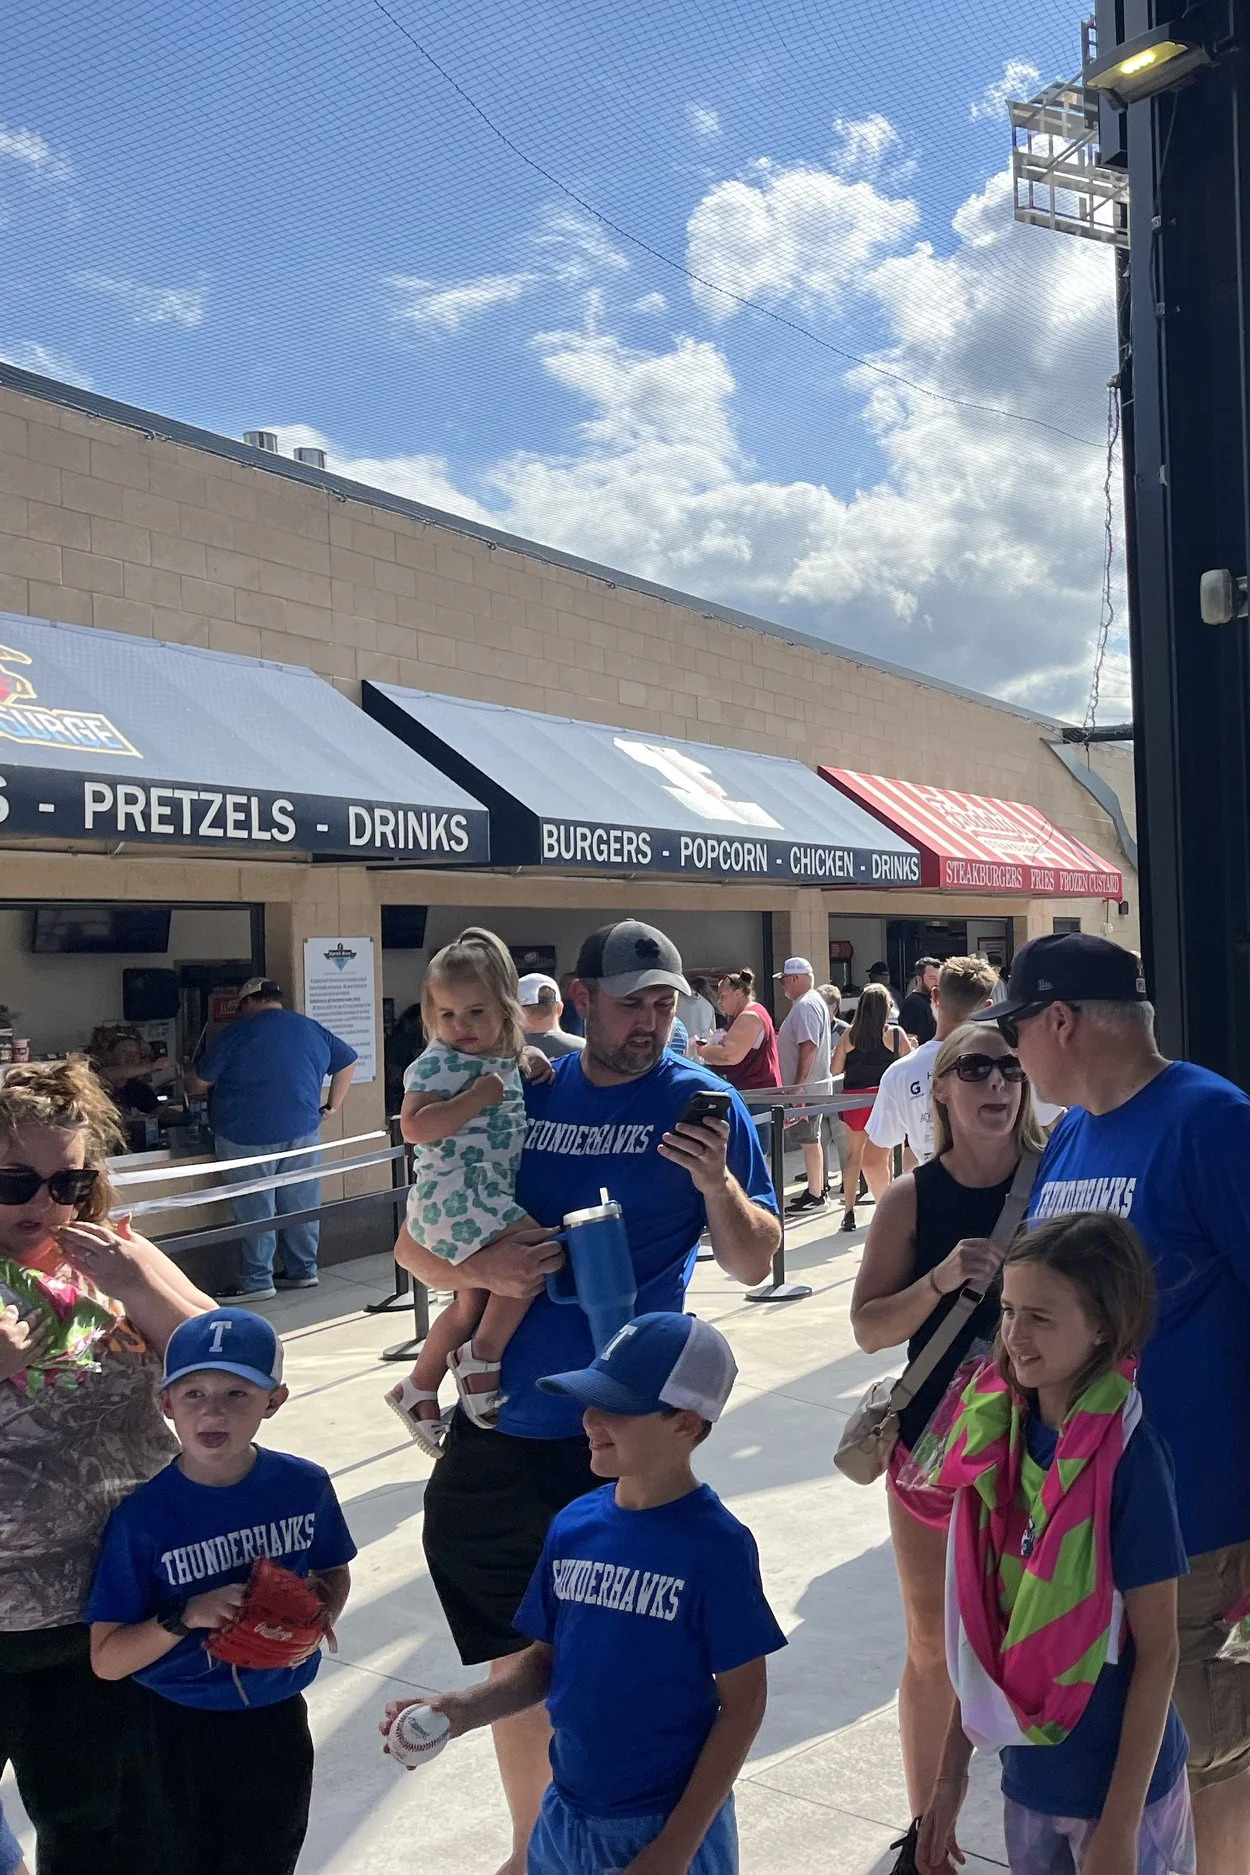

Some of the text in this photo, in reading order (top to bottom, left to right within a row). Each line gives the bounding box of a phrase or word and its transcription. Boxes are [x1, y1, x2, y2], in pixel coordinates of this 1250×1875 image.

[84, 781, 296, 842] PRETZELS
[349, 805, 469, 852] DRINKS
[543, 823, 652, 865] BURGERS
[680, 835, 767, 872] POPCORN
[789, 846, 853, 878] CHICKEN
[872, 854, 920, 882] DRINKS
[946, 860, 1120, 894] STEAKBURGERS FRIES FROZEN CUSTARD
[910, 1081, 921, 1095] G
[209, 1321, 232, 1352] T
[601, 1324, 638, 1361] T
[161, 1513, 316, 1585] THUNDERHAWKS
